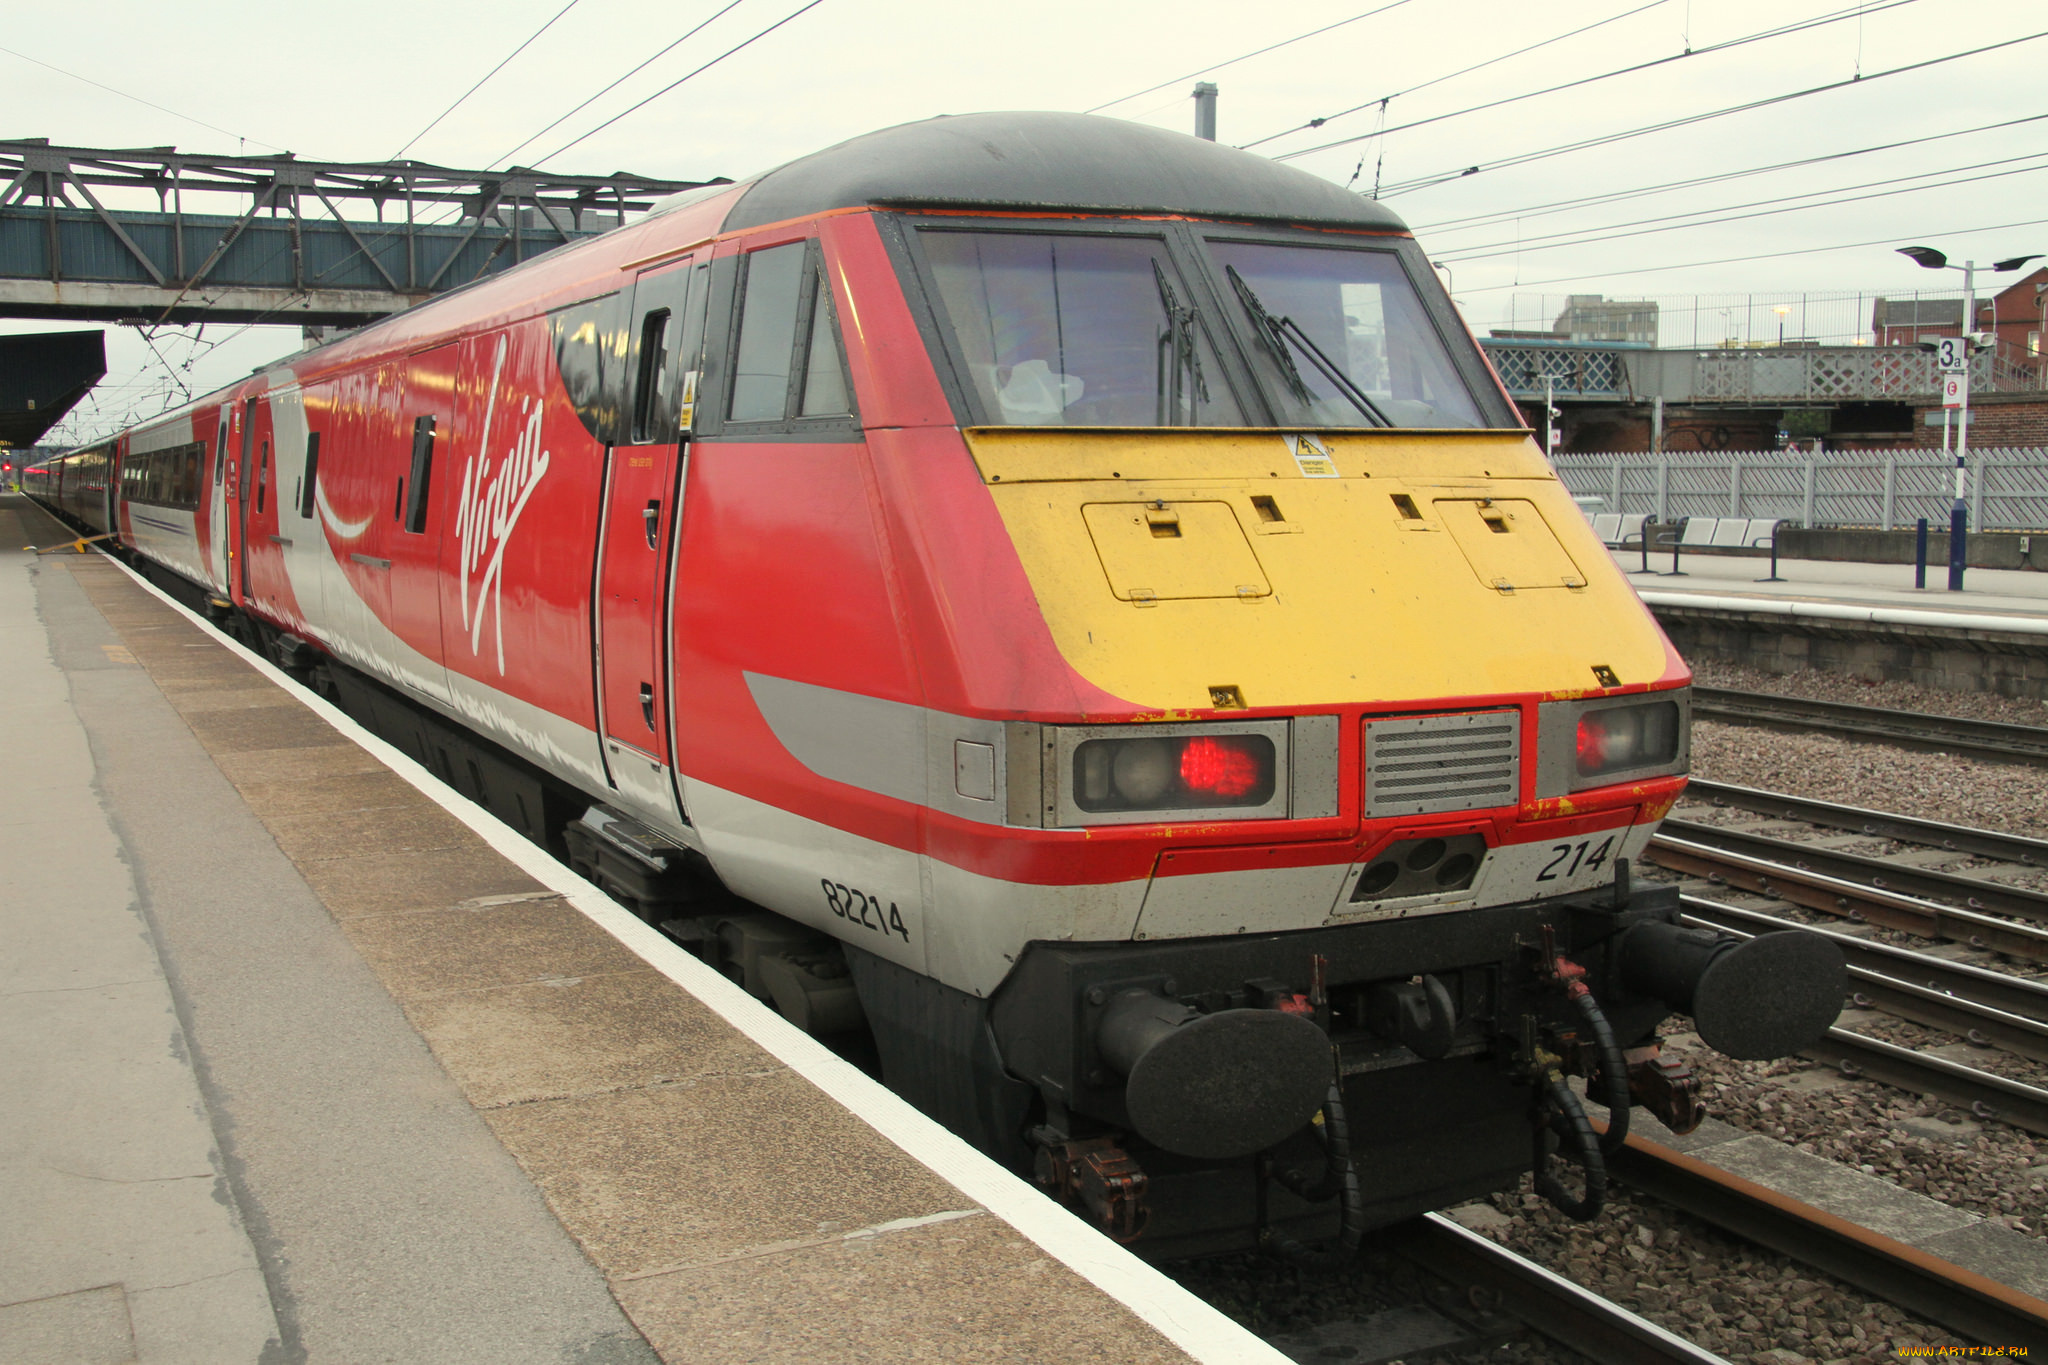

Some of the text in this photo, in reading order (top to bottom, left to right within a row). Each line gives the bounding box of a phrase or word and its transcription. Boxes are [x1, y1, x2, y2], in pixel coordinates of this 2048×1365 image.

[1940, 340, 1961, 368] 3a
[456, 334, 549, 676] Virgin
[1536, 835, 1615, 882] 214
[821, 878, 910, 943] 82214
